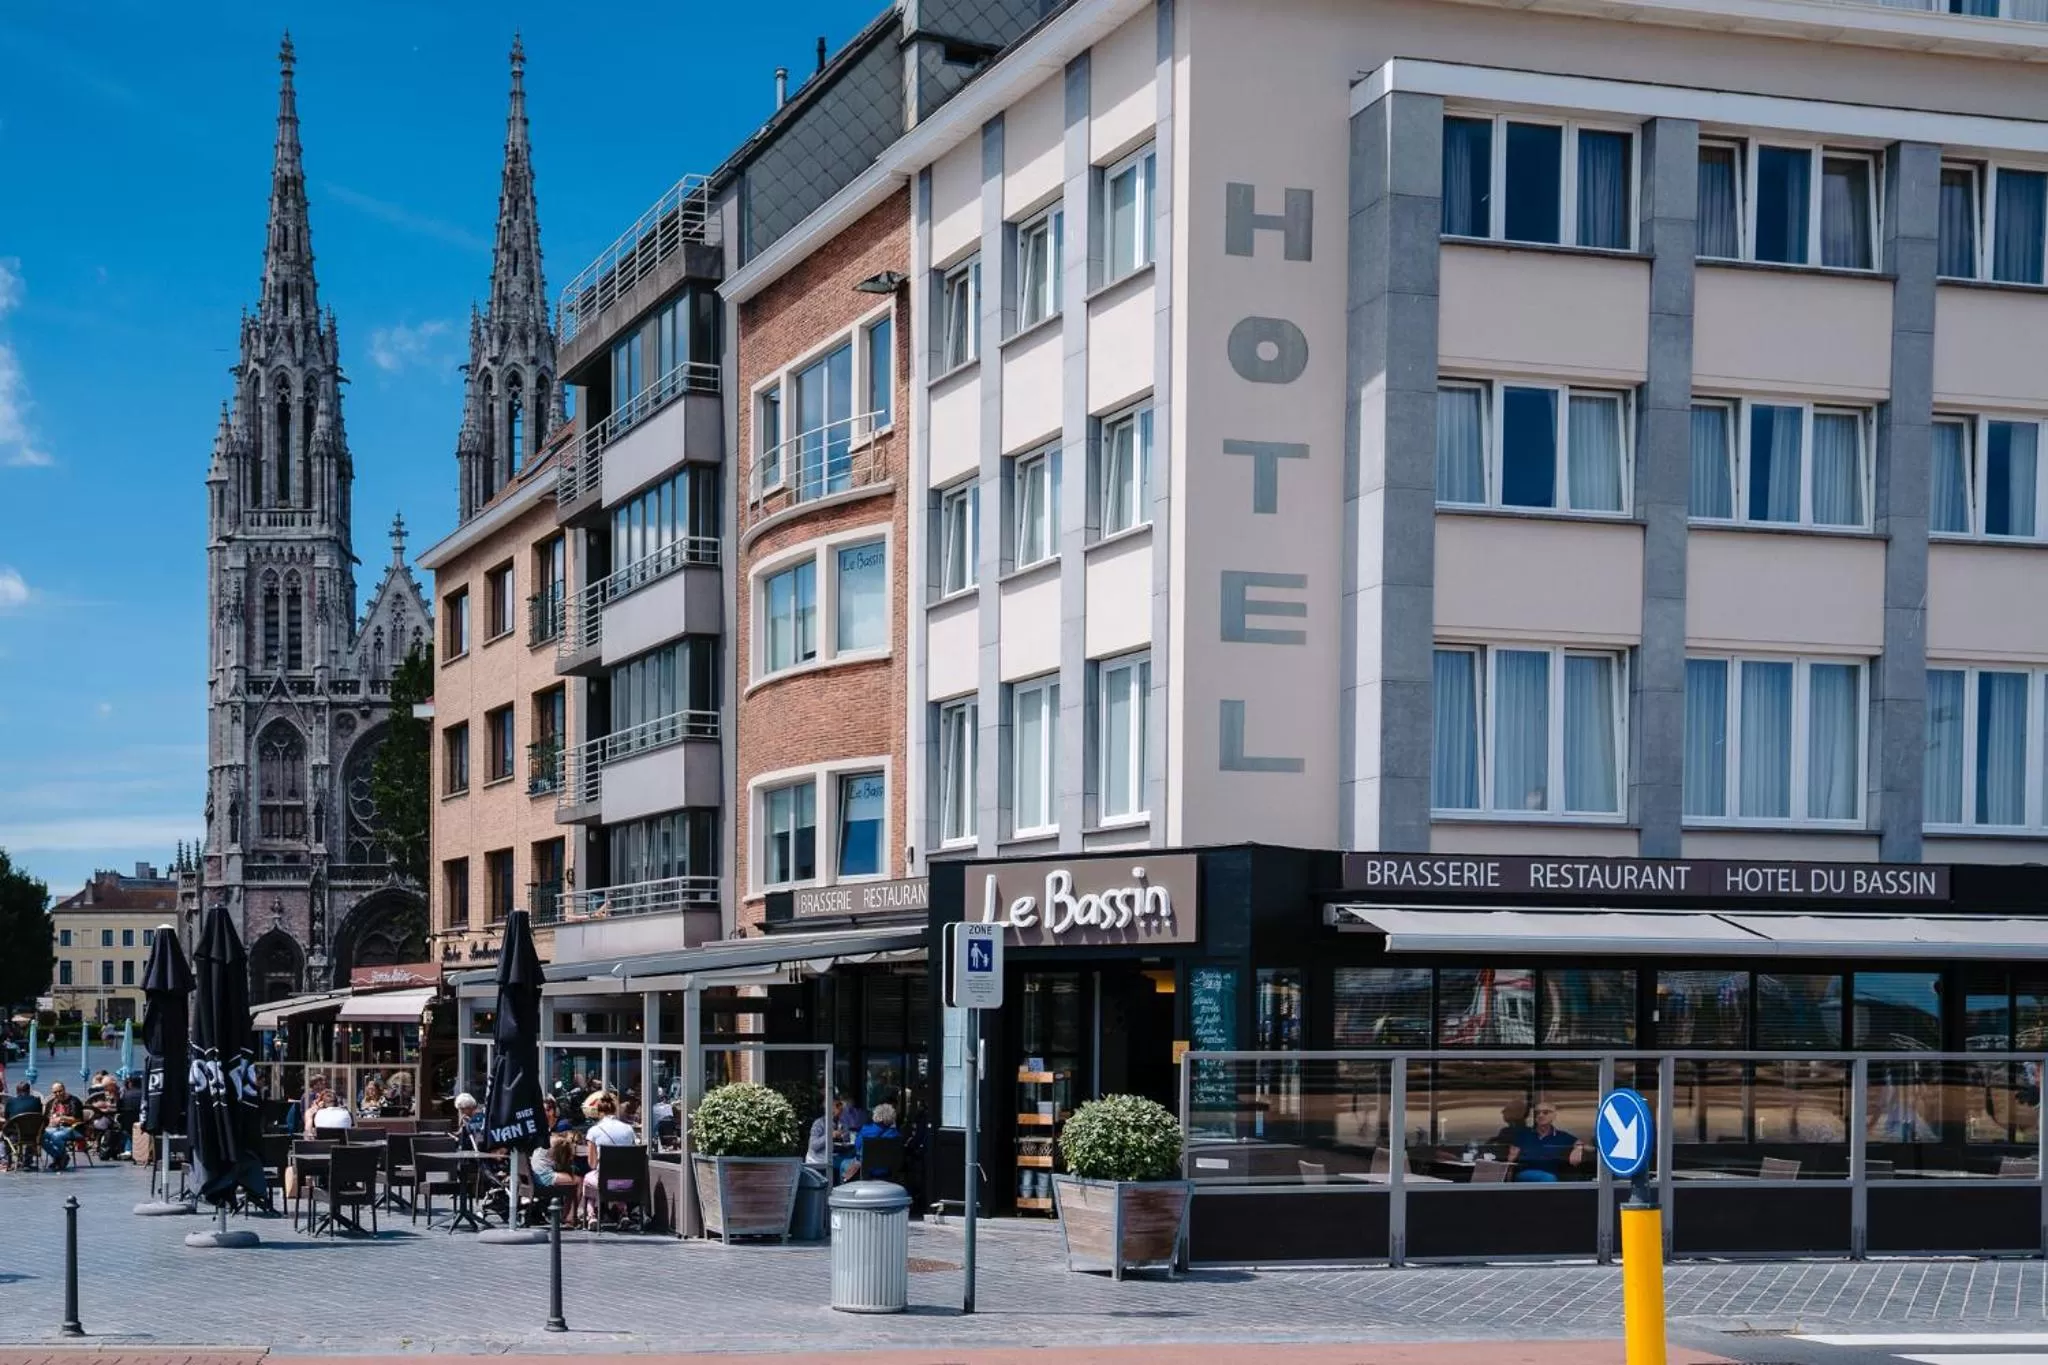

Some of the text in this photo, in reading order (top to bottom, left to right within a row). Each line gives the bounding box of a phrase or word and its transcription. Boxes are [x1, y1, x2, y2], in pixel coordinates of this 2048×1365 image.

[1219, 182, 1314, 774] HOTEL
[1366, 860, 1936, 895] BRASSERIE RESTAURANT HOTEL DU BASSIN
[800, 882, 929, 914] BRASSERIE RESTAURAN
[982, 866, 1171, 934] Le Bassin
[968, 924, 993, 935] ZONE
[491, 1123, 523, 1142] VAN
